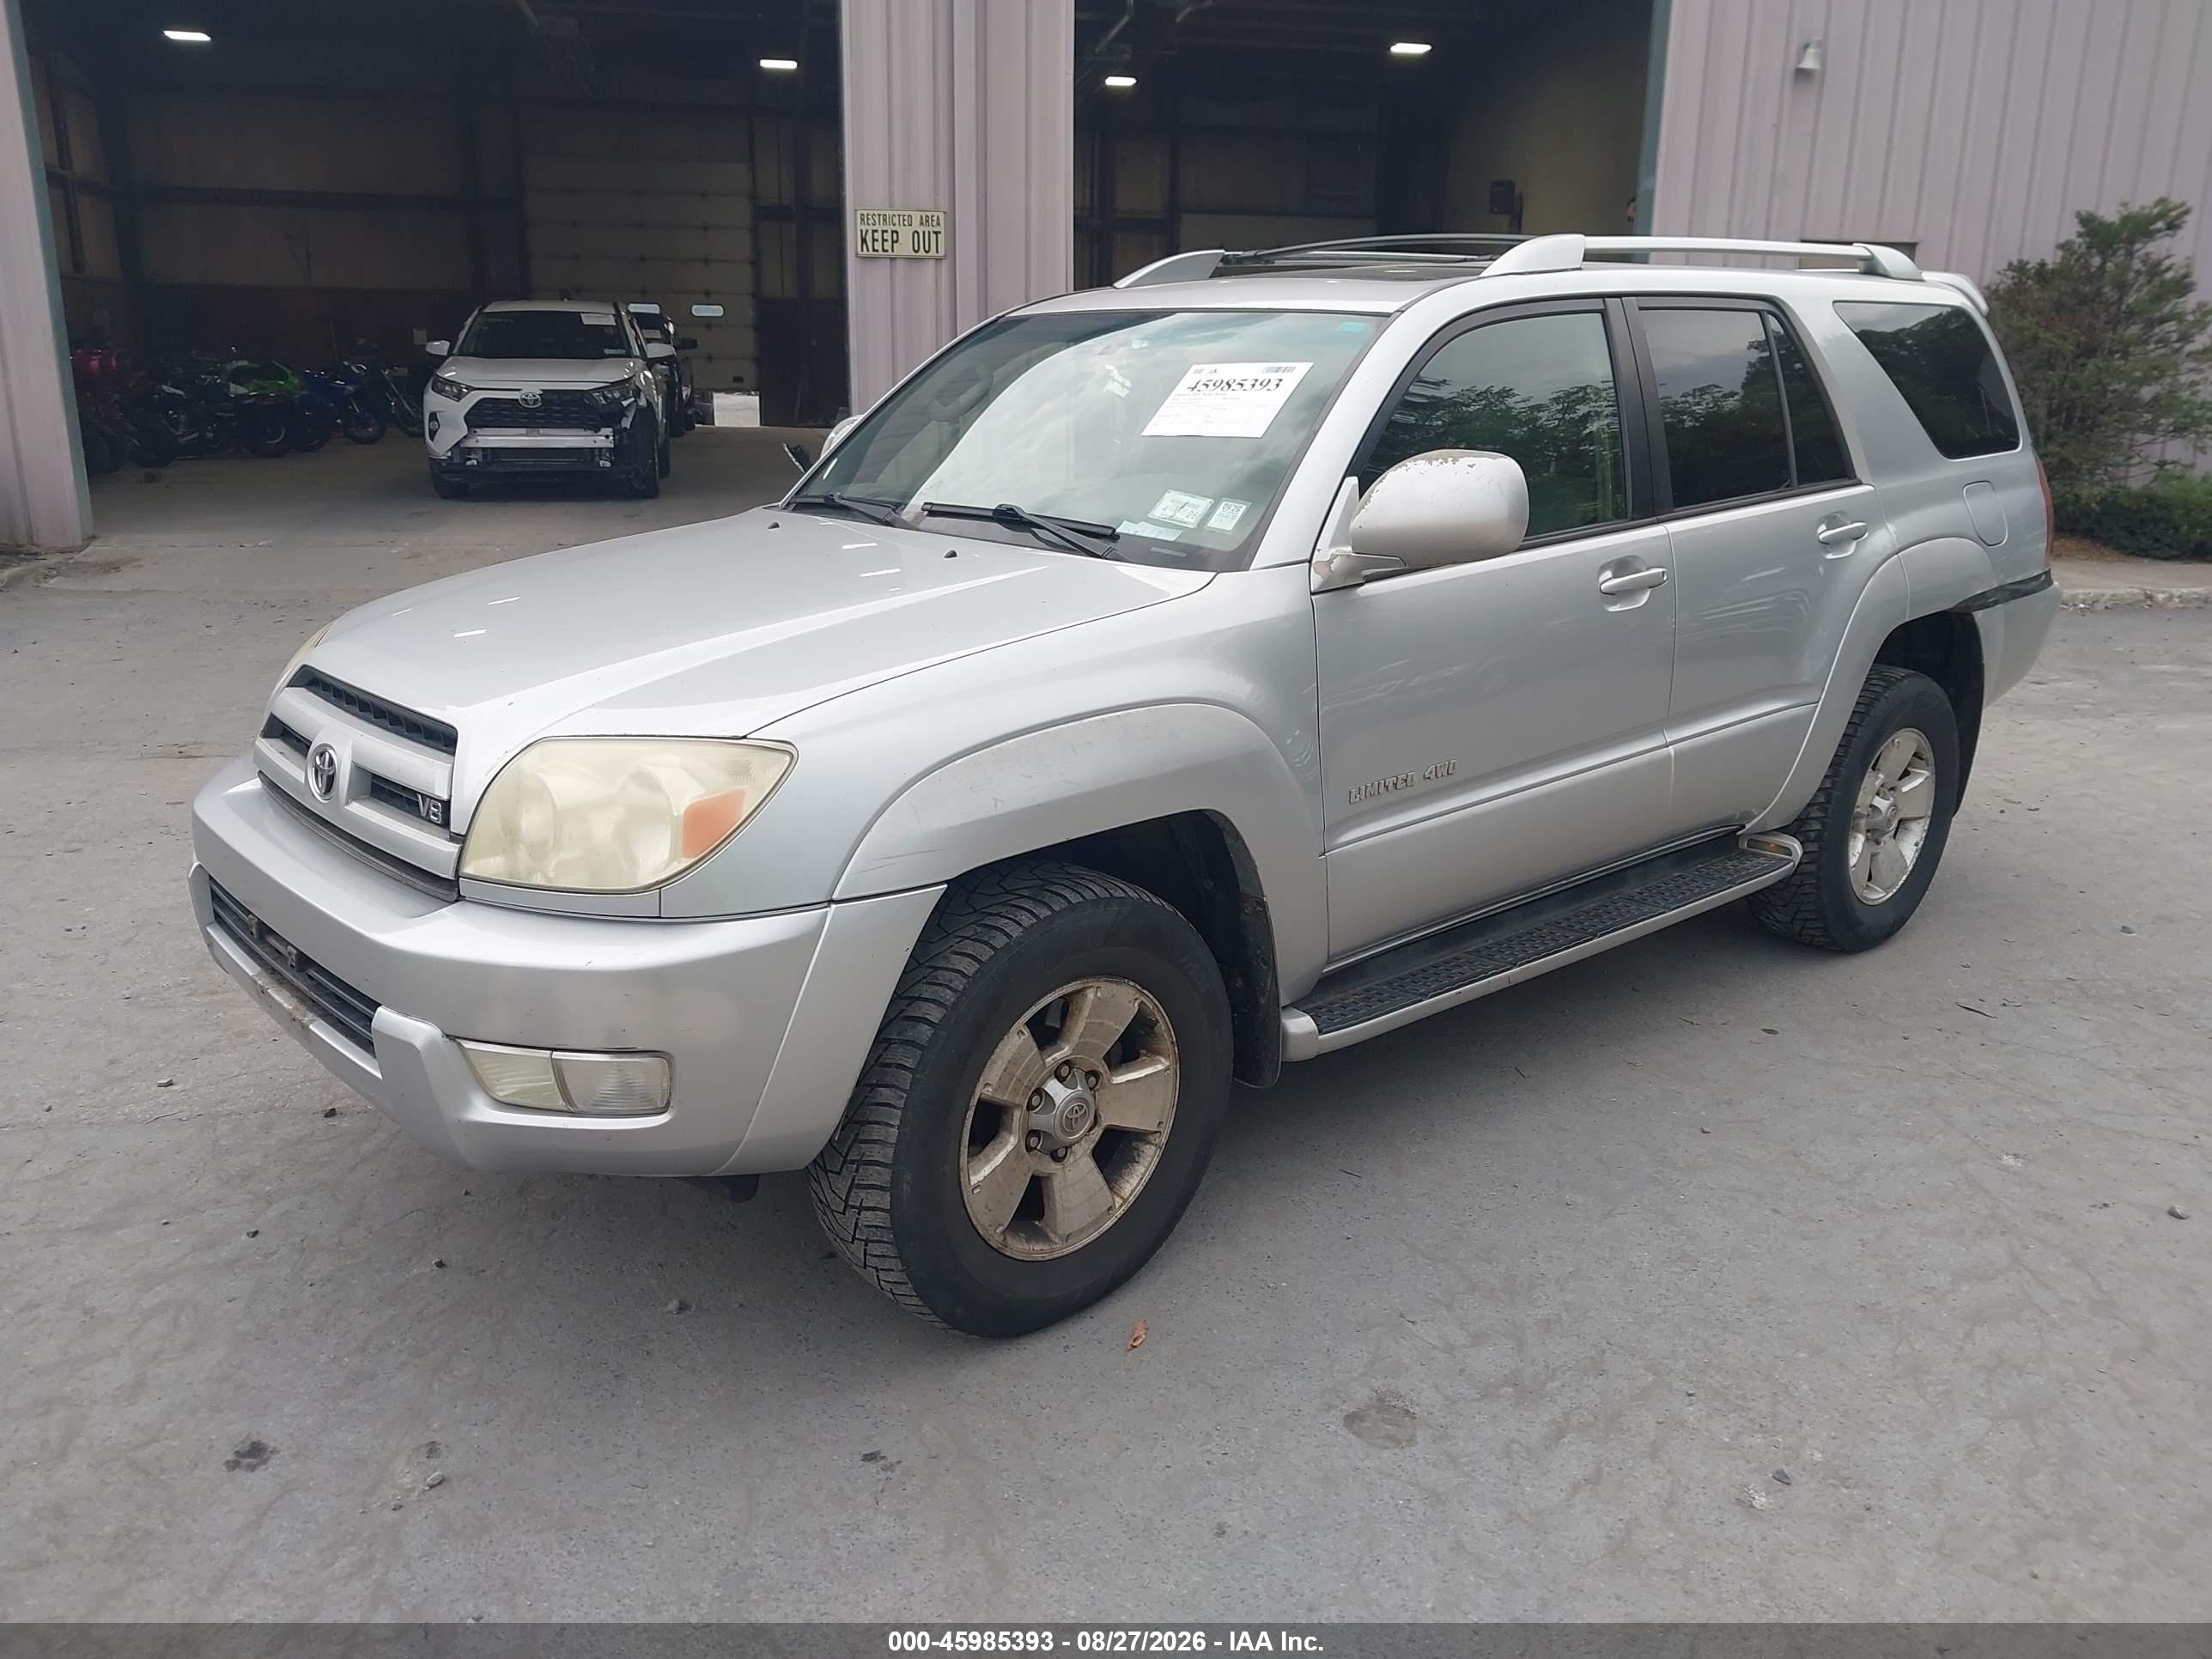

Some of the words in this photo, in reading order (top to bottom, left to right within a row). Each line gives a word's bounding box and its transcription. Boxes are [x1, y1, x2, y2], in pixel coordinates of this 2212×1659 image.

[860, 213, 913, 227] RESTRICTED
[920, 214, 941, 227] AREA
[860, 228, 899, 253] KEEP
[912, 229, 941, 254] OUT
[1187, 378, 1283, 392] 45985393
[1349, 771, 1415, 805] LIMITED
[1423, 759, 1456, 781] 4WD
[416, 793, 441, 824] V8
